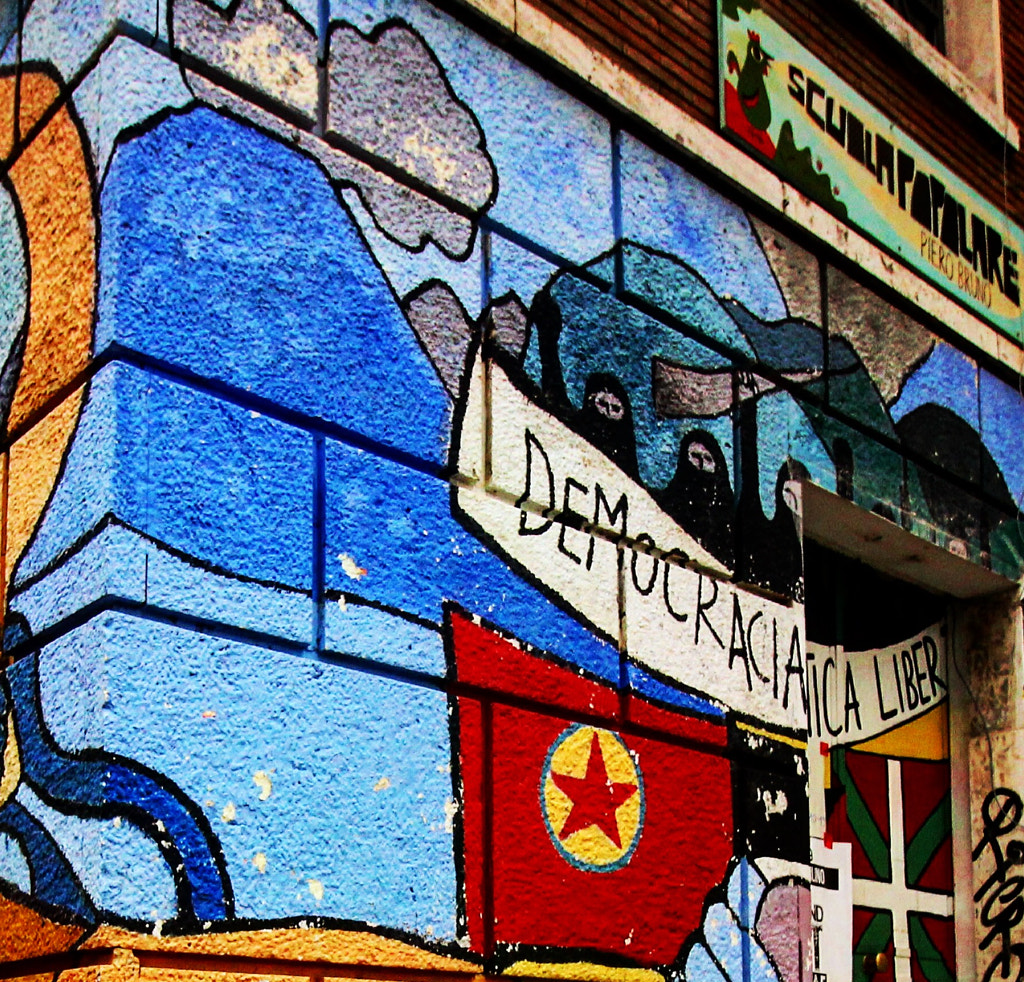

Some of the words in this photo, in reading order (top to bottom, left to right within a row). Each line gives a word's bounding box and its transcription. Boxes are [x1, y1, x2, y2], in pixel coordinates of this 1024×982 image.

[920, 230, 954, 281] PIERO
[957, 261, 992, 309] BRUNO
[518, 429, 807, 716] DEMOCRACIA
[873, 635, 947, 721] LIBER
